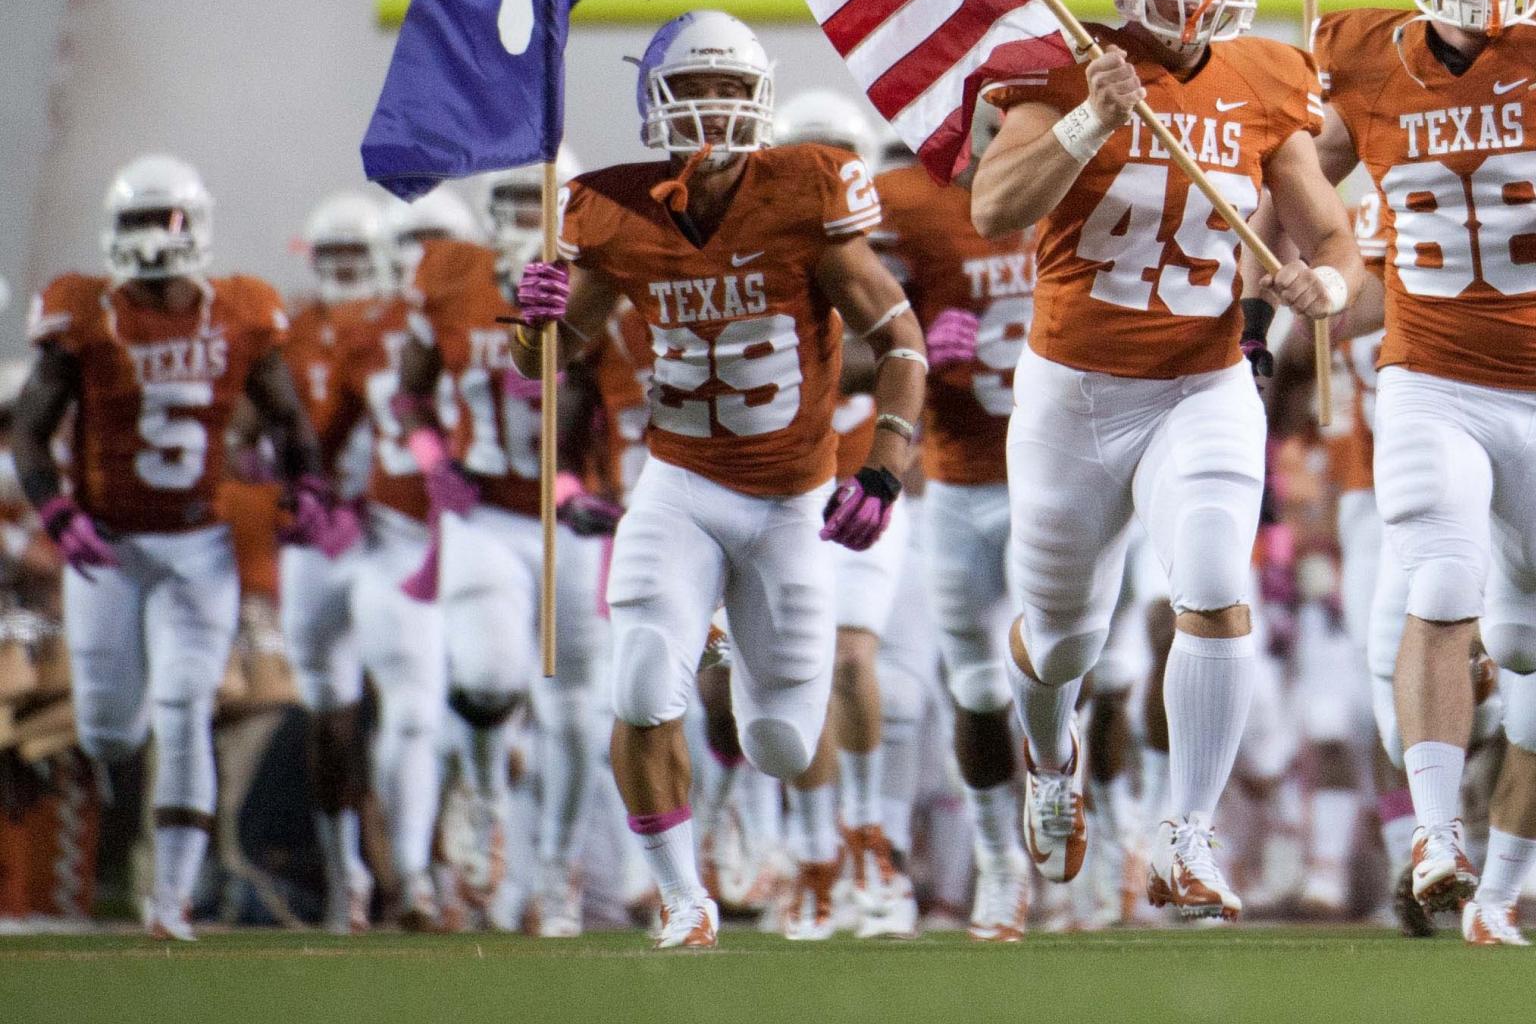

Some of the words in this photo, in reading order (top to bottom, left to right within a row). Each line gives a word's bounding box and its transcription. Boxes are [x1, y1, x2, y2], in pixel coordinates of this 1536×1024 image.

[1124, 112, 1241, 168] TEXAS
[1400, 102, 1524, 158] TEXAS
[1076, 163, 1259, 318] 49
[648, 272, 768, 324] TEXAS
[128, 337, 228, 385] TEXAS
[648, 313, 803, 438] 29
[134, 380, 214, 490] 5
